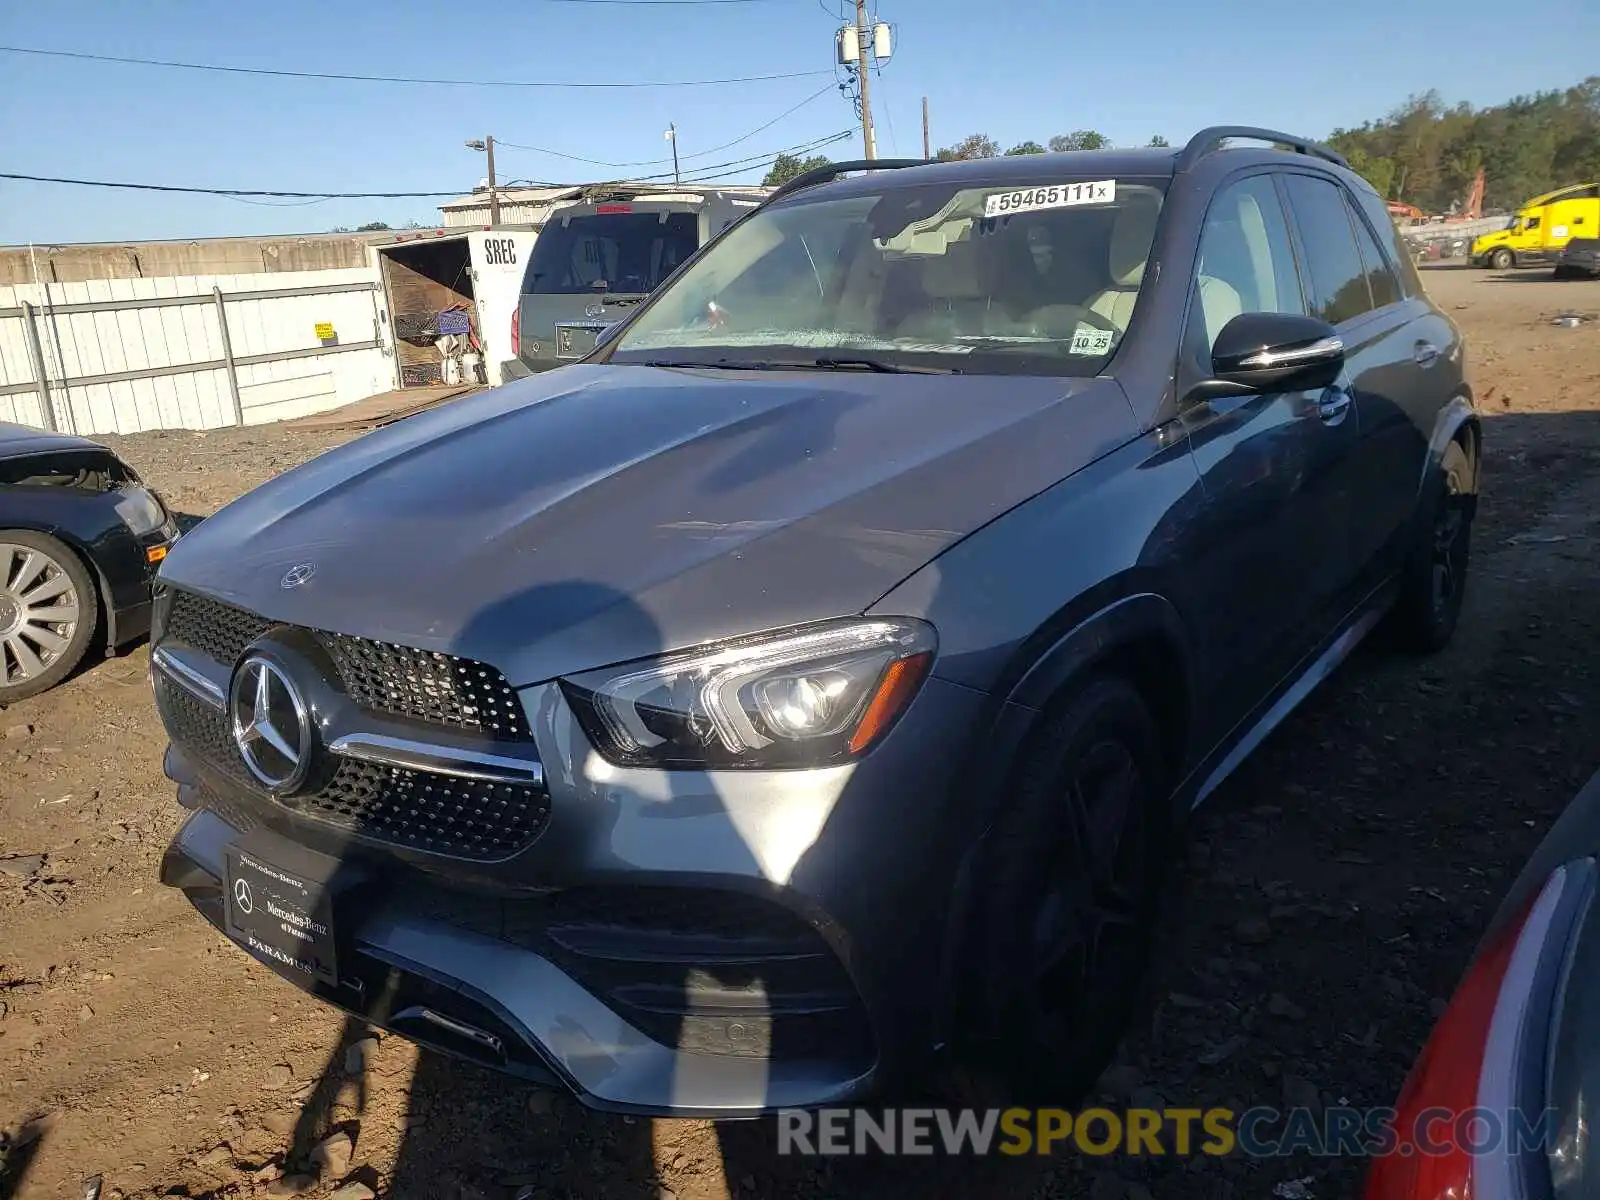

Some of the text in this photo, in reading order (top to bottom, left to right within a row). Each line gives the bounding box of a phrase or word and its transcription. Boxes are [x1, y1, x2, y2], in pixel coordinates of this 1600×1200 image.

[484, 239, 516, 265] SREC
[1074, 337, 1108, 348] 10 25
[240, 854, 304, 888] Mercedes-Benz
[267, 901, 327, 935] Mercedes-Benz
[248, 937, 313, 974] PARAMUS
